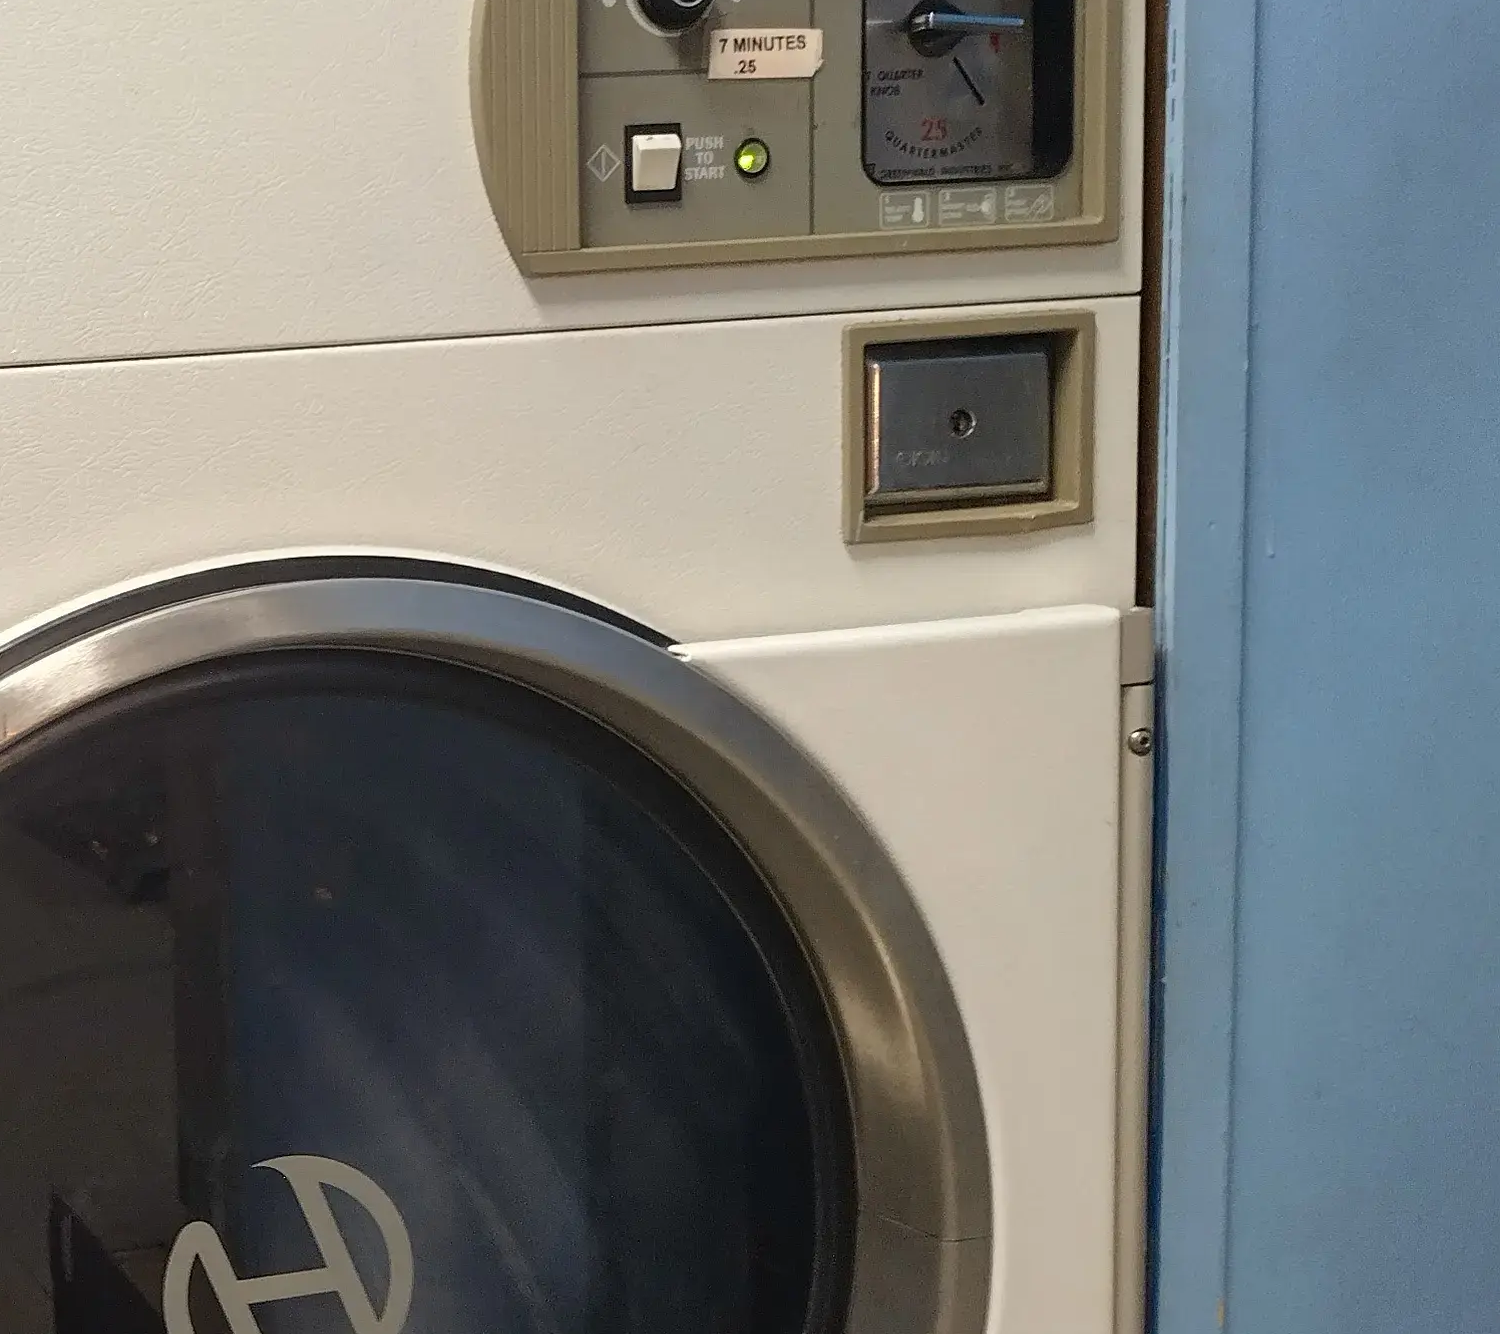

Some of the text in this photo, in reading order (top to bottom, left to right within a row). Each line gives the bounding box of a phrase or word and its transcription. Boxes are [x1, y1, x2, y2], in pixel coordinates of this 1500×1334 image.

[718, 35, 807, 54] 7 MINUTES
[733, 59, 757, 76] .25
[920, 117, 948, 142] 25
[684, 135, 725, 151] PUSH
[884, 126, 983, 159] QUARTERMASTER
[695, 151, 715, 165] TO
[684, 166, 726, 181] START
